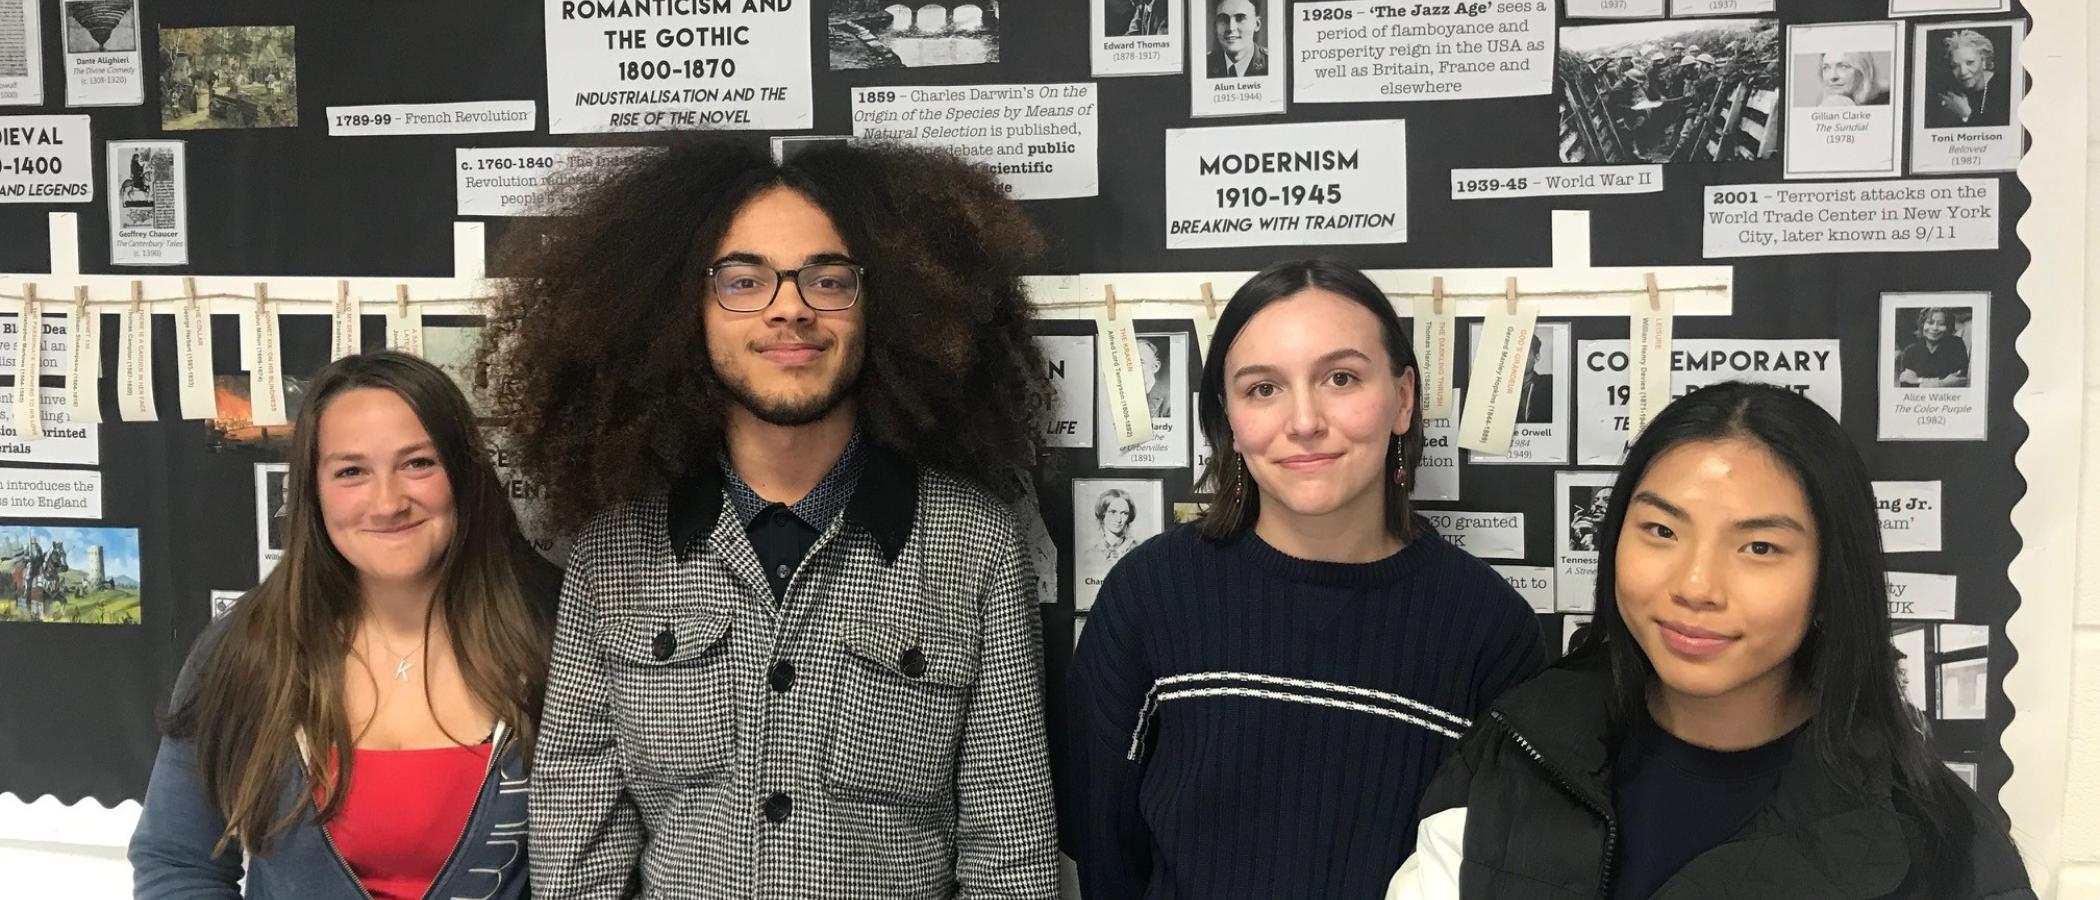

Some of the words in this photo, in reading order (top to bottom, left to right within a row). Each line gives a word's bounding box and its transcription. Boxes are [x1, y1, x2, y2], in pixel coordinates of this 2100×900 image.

[563, 0, 731, 19] ROMANTICISM
[741, 0, 793, 13] AND
[1302, 8, 1353, 22] 1920s
[1410, 4, 1451, 16] Jazz
[1497, 2, 1532, 13] sees
[1536, 2, 1547, 12] a
[604, 30, 647, 49] THE
[656, 26, 750, 48] GOTHIC
[1317, 26, 1367, 43] period
[1371, 26, 1388, 38] of
[1391, 21, 1494, 39] flamboyance
[1498, 20, 1529, 33] and
[1103, 42, 1135, 51] Edward
[1136, 40, 1171, 49] Thomas
[1301, 45, 1385, 63] prosperity
[1389, 43, 1432, 59] reign
[1436, 42, 1452, 55] in
[1456, 41, 1483, 54] the
[1487, 39, 1522, 53] USA
[1526, 40, 1545, 51] as
[97, 57, 130, 65] Alighieri
[1113, 52, 1161, 62] (1878-1917)
[618, 58, 736, 81] 1800-1870
[1315, 65, 1346, 79] well
[1350, 66, 1369, 77] as
[1373, 63, 1434, 77] Britain,
[1439, 61, 1496, 74] France
[1500, 58, 1530, 72] and
[858, 91, 896, 104] 1859
[911, 89, 966, 102] Charles
[970, 86, 1035, 101] Darwin's
[1039, 87, 1059, 98] On
[1063, 85, 1088, 98] the
[1214, 83, 1235, 91] Alun
[1237, 82, 1261, 90] Lewis
[1380, 80, 1463, 95] elsewhere
[576, 89, 718, 106] INDUSTRIALISATION
[722, 87, 755, 102] AND
[760, 87, 788, 101] THE
[1213, 92, 1262, 103] (1915-1944)
[336, 113, 391, 127] 1789-99
[405, 111, 451, 125] French
[455, 110, 528, 123] Revolution
[610, 112, 639, 126] RISE
[644, 111, 668, 125] OF
[670, 111, 696, 124] THE
[700, 110, 751, 123] NOVEL
[854, 110, 898, 123] Origin
[901, 109, 919, 122] of
[919, 107, 943, 120] the
[946, 106, 1000, 121] Species
[1003, 106, 1022, 120] by
[1025, 105, 1074, 118] Means
[1077, 103, 1095, 117] of
[1811, 111, 1840, 120] Gillian
[1842, 110, 1871, 120] Clarke
[863, 128, 918, 140] Natural
[921, 126, 987, 139] Selection
[990, 125, 1003, 137] is
[1007, 123, 1082, 138] published,
[1815, 123, 1832, 132] The
[1833, 122, 1869, 132] Sundial
[1826, 135, 1855, 145] (1978)
[1931, 133, 1954, 143] Toni
[1957, 132, 2003, 142] Morrison
[997, 143, 1024, 155] and
[1027, 142, 1076, 156] public
[461, 161, 473, 171] c.
[477, 157, 554, 170] 1760-1840
[1200, 149, 1359, 176] MODERNISM
[1951, 155, 1982, 166] (1987)
[28, 183, 88, 196] LEGENDS
[465, 175, 537, 188] Revolution
[1457, 177, 1528, 193] 1939-45
[1546, 174, 1595, 189] World
[1600, 173, 1634, 187] War
[1638, 172, 1652, 185] II
[1216, 184, 1342, 208] 1910-1945
[1713, 191, 1759, 205] 2001
[1776, 189, 1856, 203] Terrorist
[1860, 186, 1925, 201] attacks
[1930, 188, 1951, 200] on
[1957, 185, 1987, 199] the
[1170, 217, 1253, 235] BREAKING
[1259, 216, 1300, 231] WITH
[1305, 213, 1396, 230] TRADITION
[1708, 210, 1759, 225] World
[1763, 209, 1814, 222] Trade
[1818, 208, 1877, 222] Center
[1881, 206, 1899, 220] in
[1903, 207, 1941, 220] New
[1947, 206, 1992, 219] York
[119, 231, 146, 239] Geoffrey
[149, 230, 178, 238] Chaucer
[1739, 229, 1777, 246] City,
[1782, 228, 1824, 242] later
[1828, 226, 1886, 241] known
[1891, 229, 1910, 240] as
[1915, 226, 1957, 241] 9/11
[1503, 326, 1513, 351] Gerard
[1641, 317, 1649, 343] William
[1108, 330, 1116, 350] Alfred
[1423, 350, 1432, 370] Hardy
[1496, 350, 1508, 375] Manley
[1640, 344, 1648, 365] Henry
[1639, 367, 1647, 391] Davies
[1490, 375, 1502, 404] Hopkins
[1904, 393, 1926, 402] Alice
[1929, 393, 1961, 402] Walker
[1894, 404, 1912, 413] The
[1914, 404, 1939, 413] Color
[1941, 404, 1973, 415] Purple
[1917, 416, 1947, 425] (1982)
[1521, 428, 1552, 437] Orwell
[7, 481, 71, 492] introduces
[74, 481, 94, 492] the
[11, 497, 35, 507] into
[38, 496, 88, 509] England
[1905, 498, 1933, 511] Jr.
[1456, 516, 1518, 531] granted
[1532, 577, 1547, 589] to
